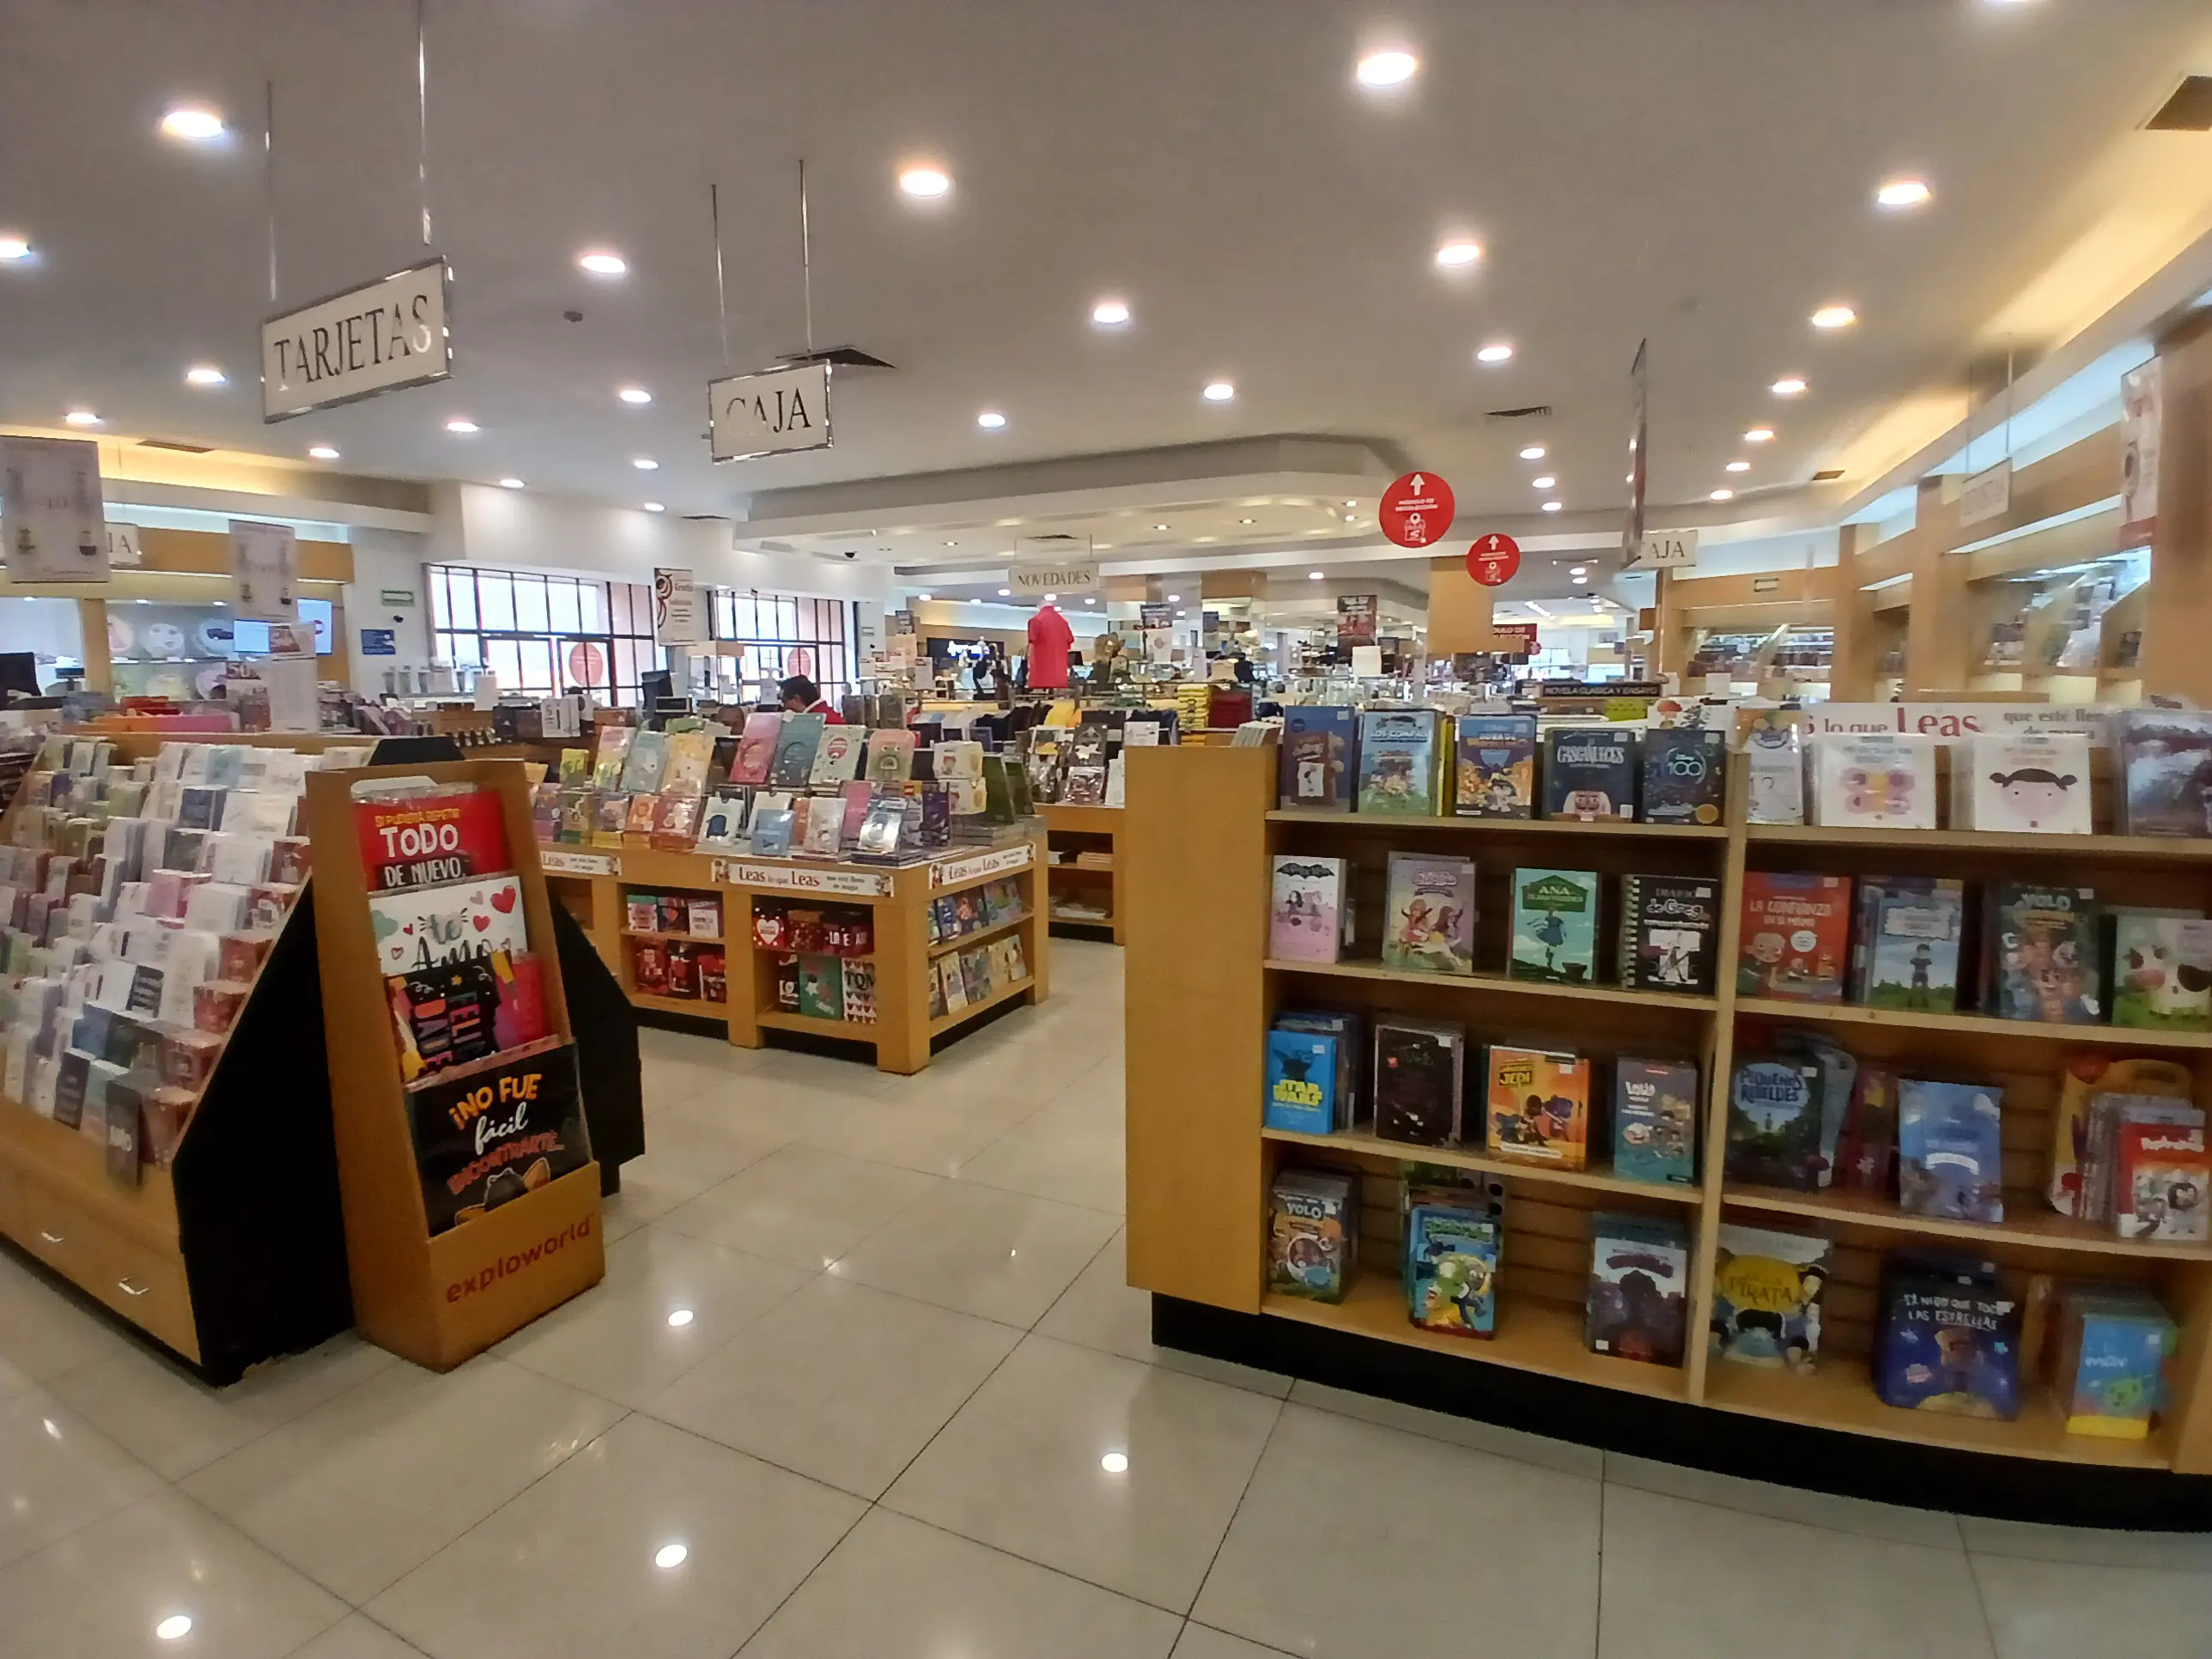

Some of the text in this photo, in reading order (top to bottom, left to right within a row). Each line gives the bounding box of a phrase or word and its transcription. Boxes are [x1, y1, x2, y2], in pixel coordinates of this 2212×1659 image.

[274, 294, 432, 392] TARJETAS
[726, 386, 811, 435] CAJA
[1018, 569, 1091, 586] NOVEDADES
[1896, 707, 1985, 738] Leas
[1667, 761, 1702, 776] 100
[380, 823, 459, 858] TODO
[384, 864, 406, 888] DE
[739, 866, 765, 883] Leas
[791, 871, 820, 887] Leas
[1539, 885, 1571, 896] ANA
[499, 1073, 543, 1104] FUE
[475, 1101, 529, 1156] fácil
[1287, 1202, 1323, 1219] YOLO
[446, 1215, 591, 1304] exploworld
[1908, 1310, 1930, 1322] LAS
